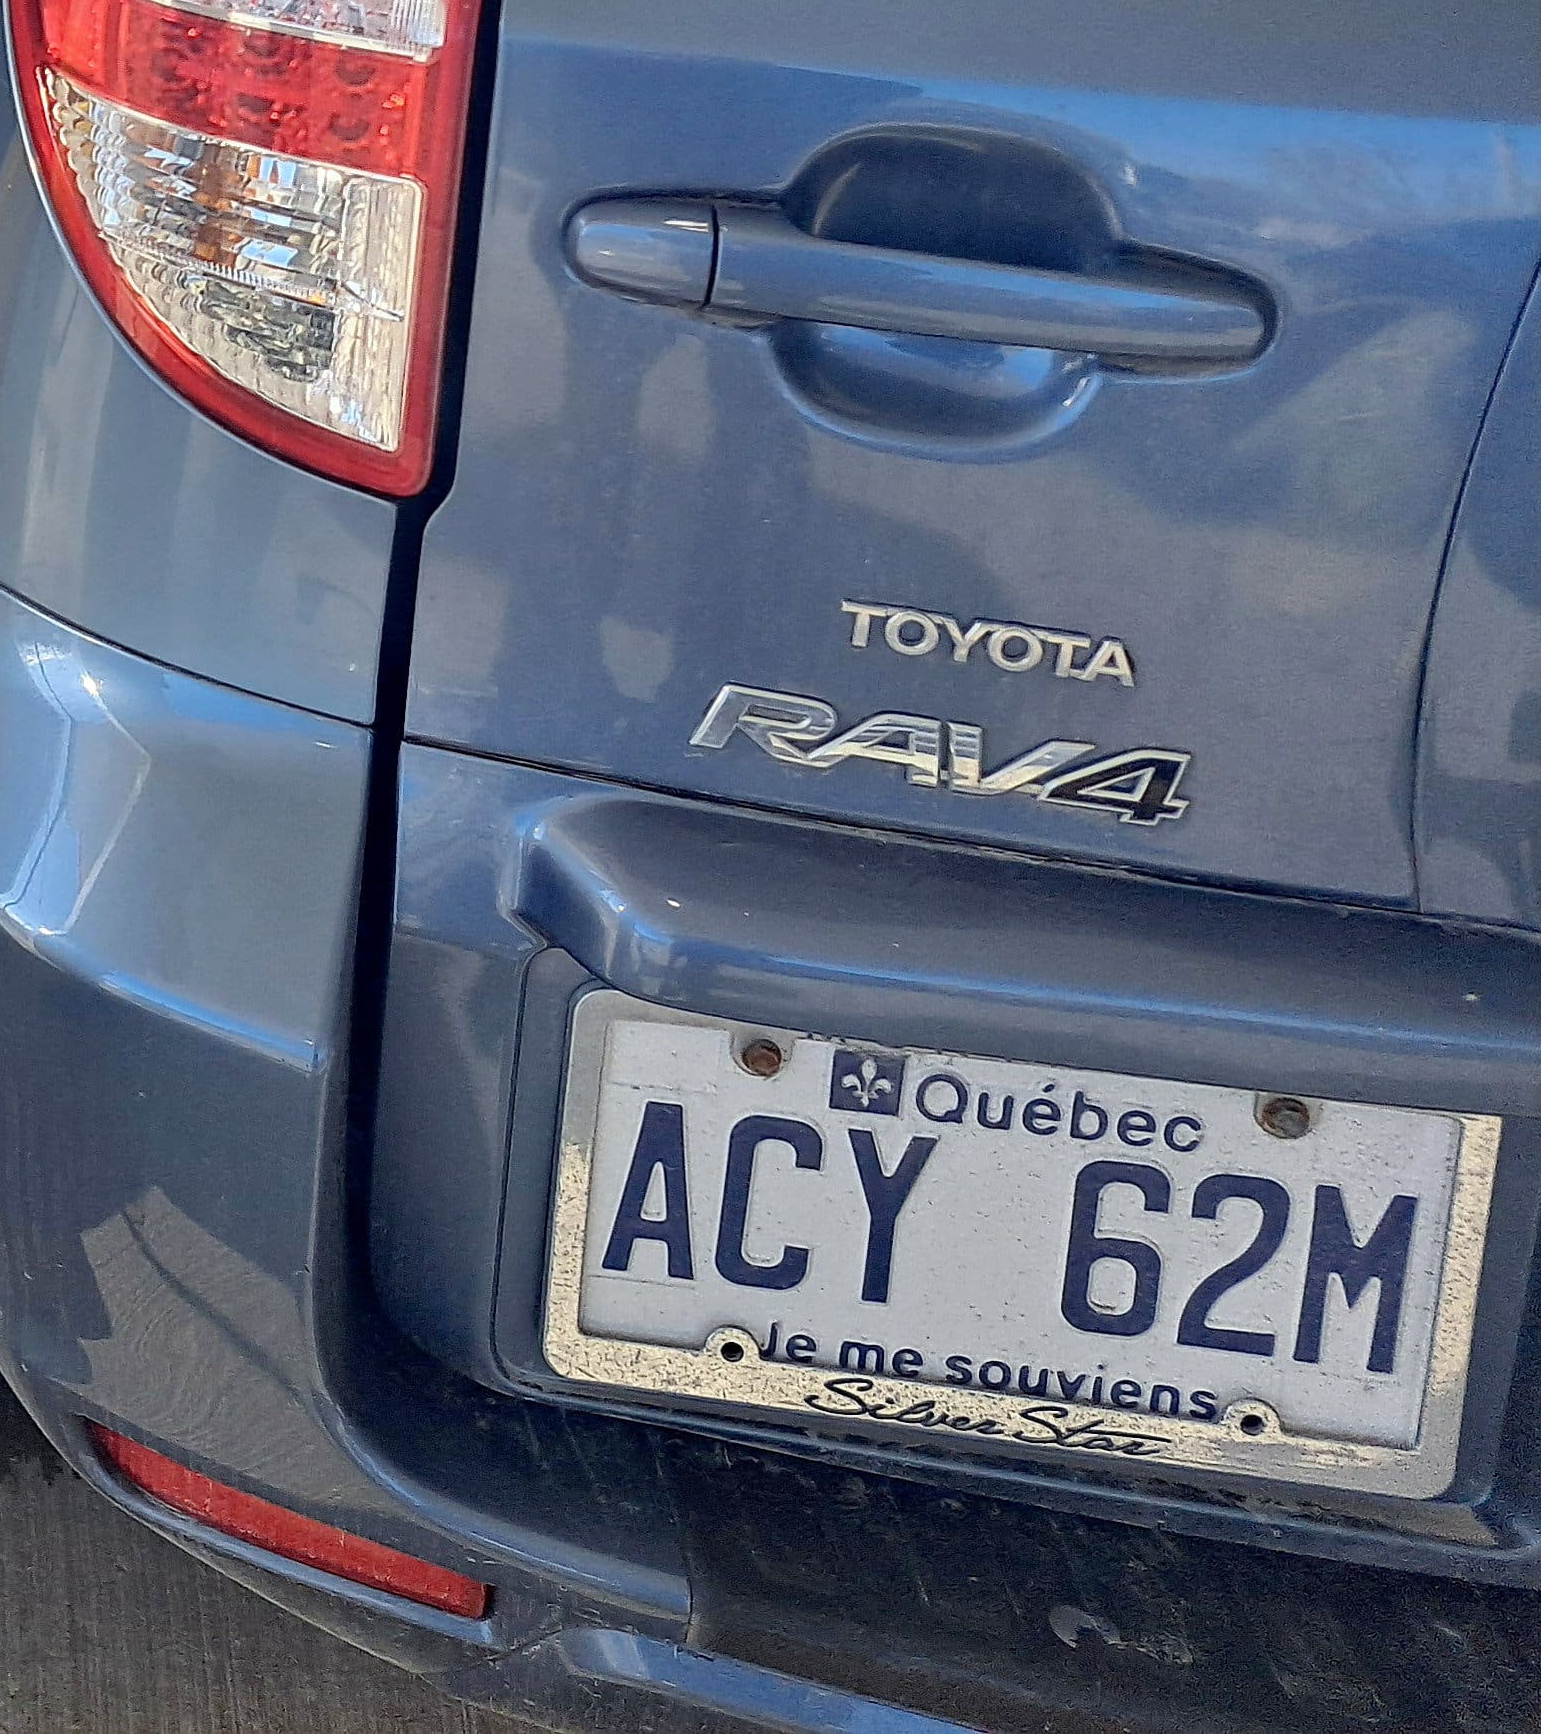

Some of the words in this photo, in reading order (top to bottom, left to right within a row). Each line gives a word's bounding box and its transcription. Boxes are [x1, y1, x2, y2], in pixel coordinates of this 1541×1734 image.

[840, 597, 1136, 688] TOYOTA
[687, 681, 1193, 827] RAV4
[914, 1072, 1204, 1155] Québec
[600, 1100, 938, 1304] ACY
[1060, 1159, 1419, 1376] 62M
[759, 1321, 817, 1367] Je
[838, 1337, 925, 1381] me
[943, 1354, 1220, 1424] souviens
[1007, 1403, 1172, 1457] Star
